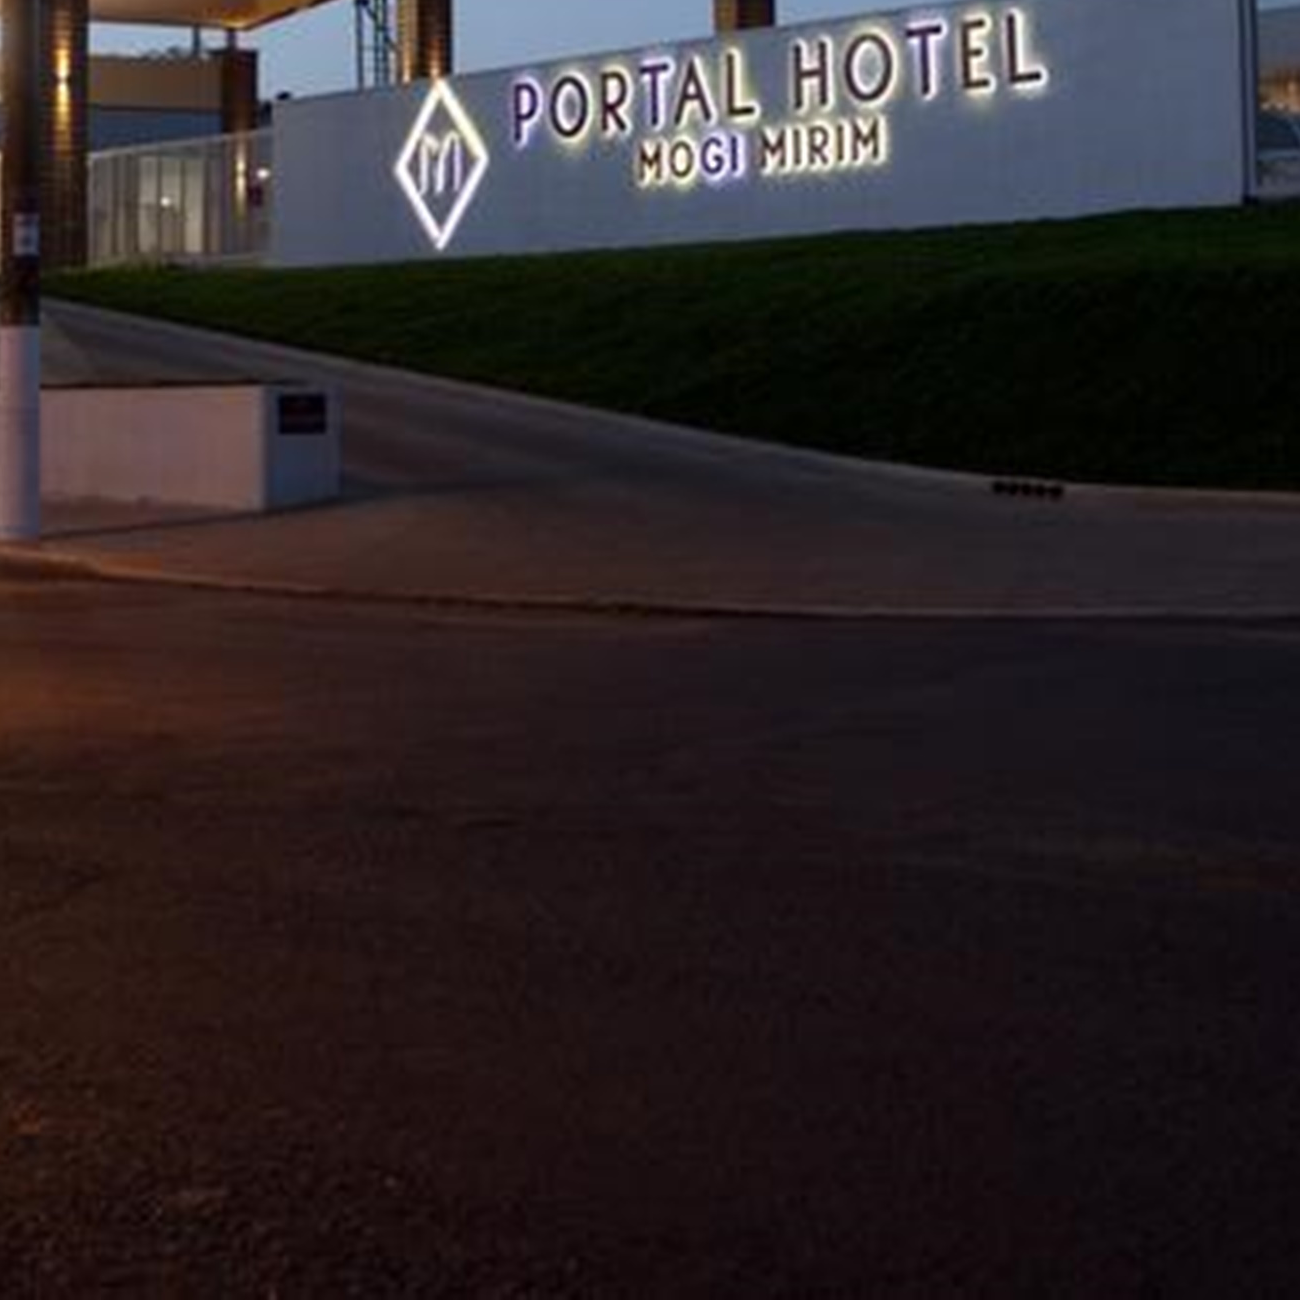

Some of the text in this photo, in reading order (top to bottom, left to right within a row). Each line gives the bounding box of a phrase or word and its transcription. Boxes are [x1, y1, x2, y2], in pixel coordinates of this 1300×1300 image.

[511, 11, 1046, 144] PORTAL HOTEL
[637, 115, 886, 184] MOGI MIRIM
